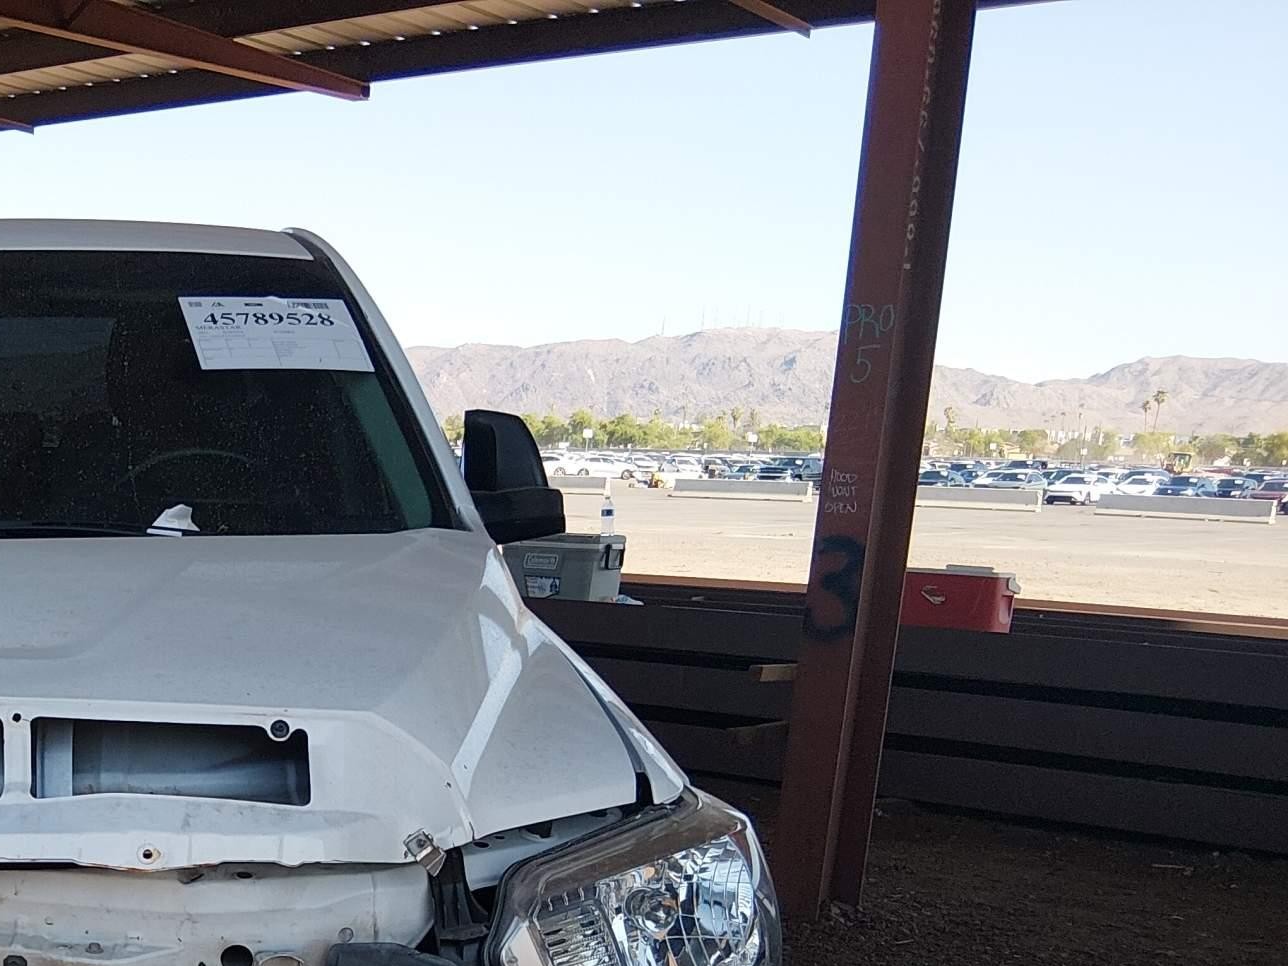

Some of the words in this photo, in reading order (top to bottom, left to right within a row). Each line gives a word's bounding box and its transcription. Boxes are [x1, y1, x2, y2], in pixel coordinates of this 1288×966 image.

[203, 312, 335, 327] 45789528
[850, 343, 881, 384] 5
[824, 500, 857, 514] OPEN
[802, 534, 865, 641] 3
